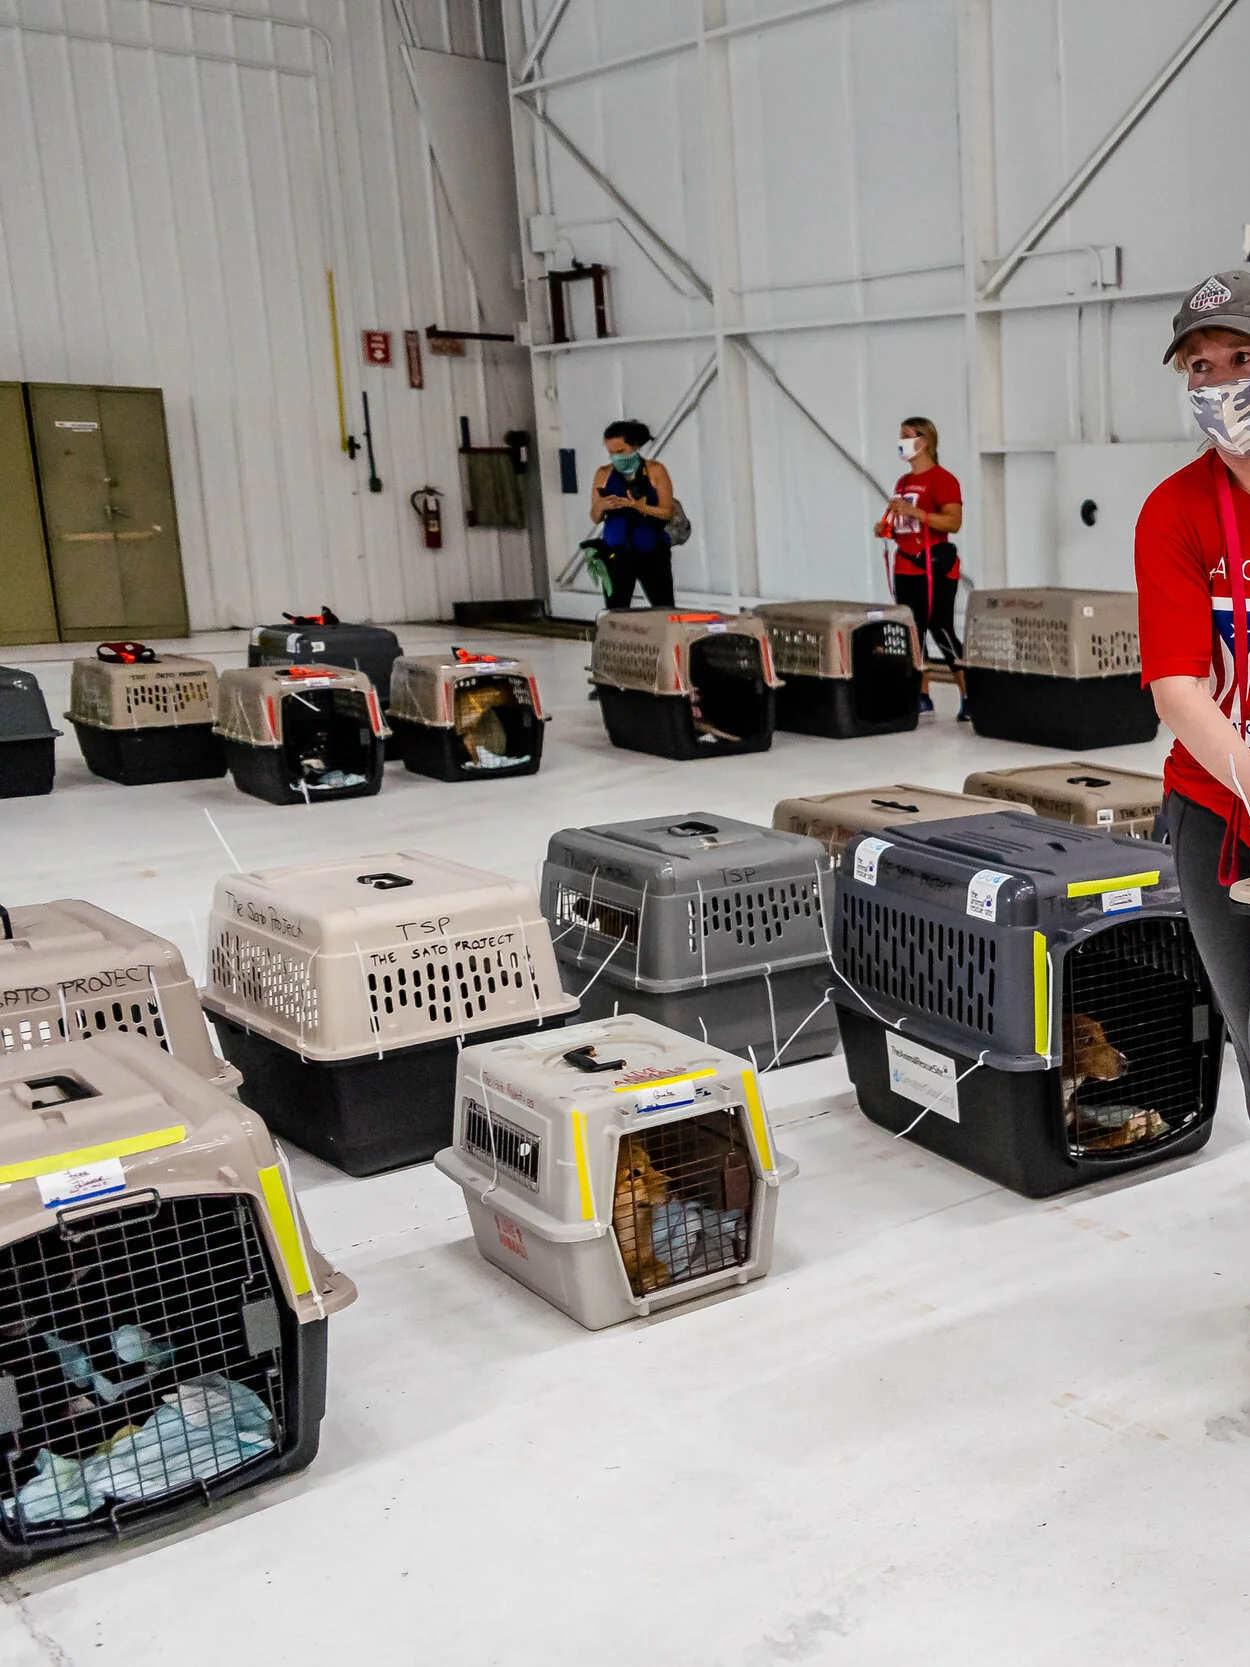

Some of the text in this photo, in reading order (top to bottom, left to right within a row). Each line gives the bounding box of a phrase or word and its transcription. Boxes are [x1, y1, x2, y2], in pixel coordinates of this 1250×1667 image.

[718, 866, 756, 885] TSP
[396, 917, 451, 941] TSP
[370, 933, 515, 967] THE SATO PROJECT
[0, 964, 155, 1008] ATO PROJECT
